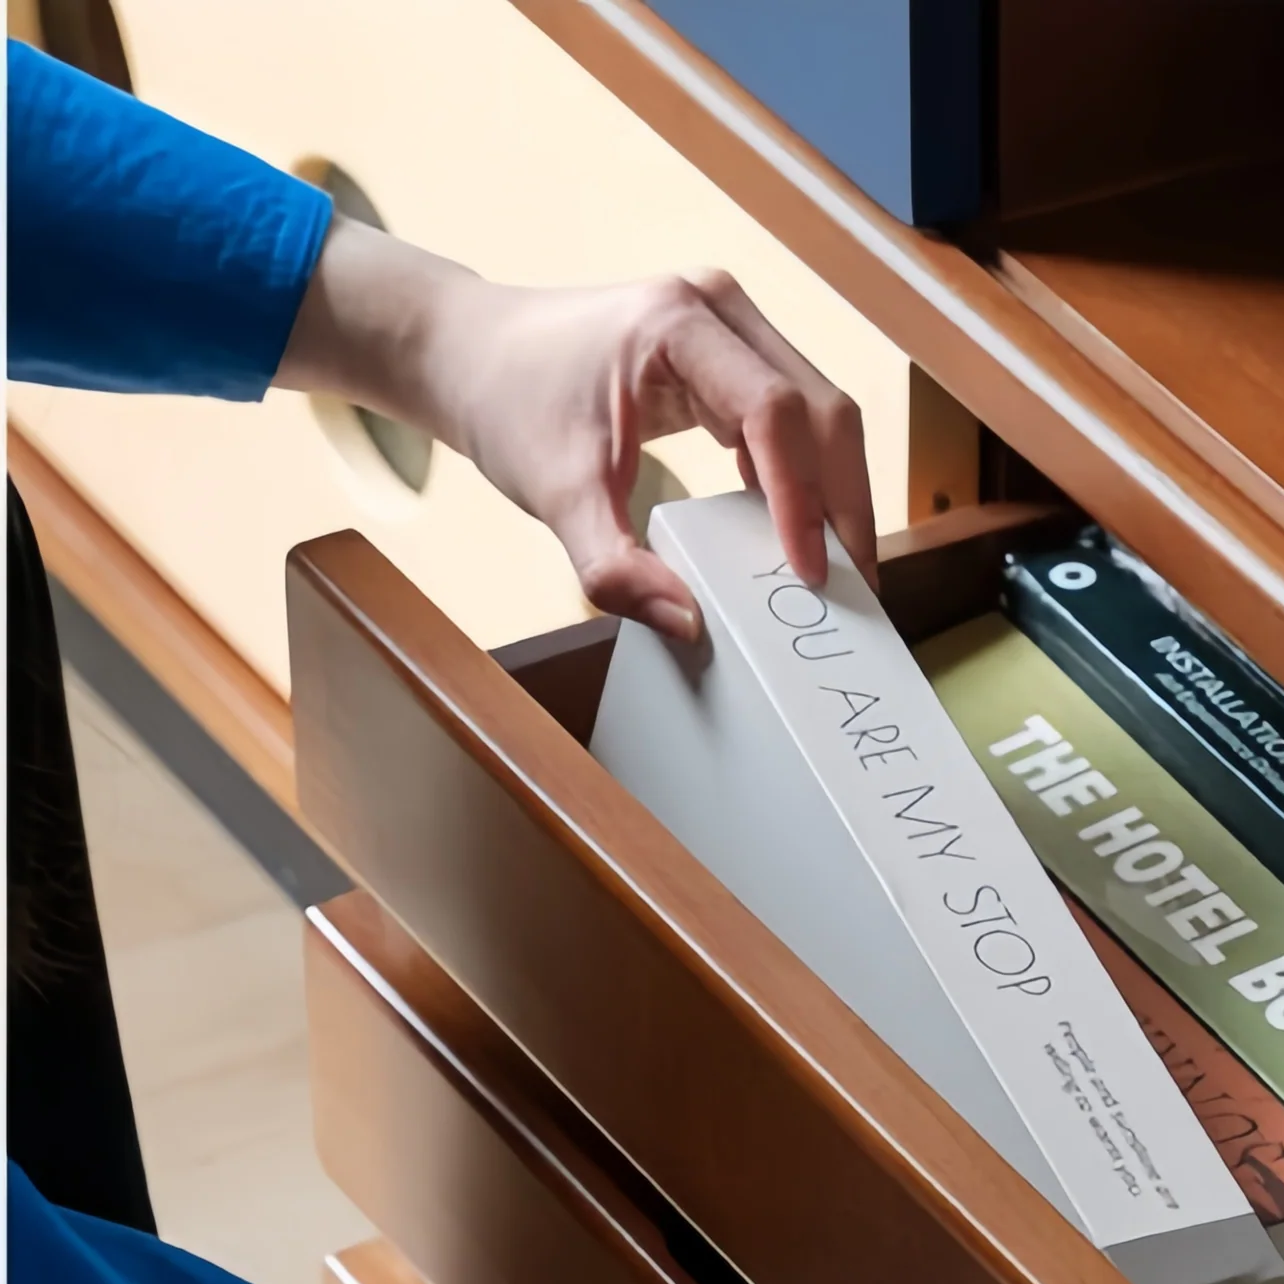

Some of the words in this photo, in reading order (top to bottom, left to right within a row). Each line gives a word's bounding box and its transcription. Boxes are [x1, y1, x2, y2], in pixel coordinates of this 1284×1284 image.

[752, 561, 854, 661] YOU
[819, 685, 918, 771] ARE
[882, 785, 976, 861] MY
[944, 885, 1051, 996] STOP
[988, 715, 1118, 817] THE
[1078, 807, 1259, 966] HOTEL
